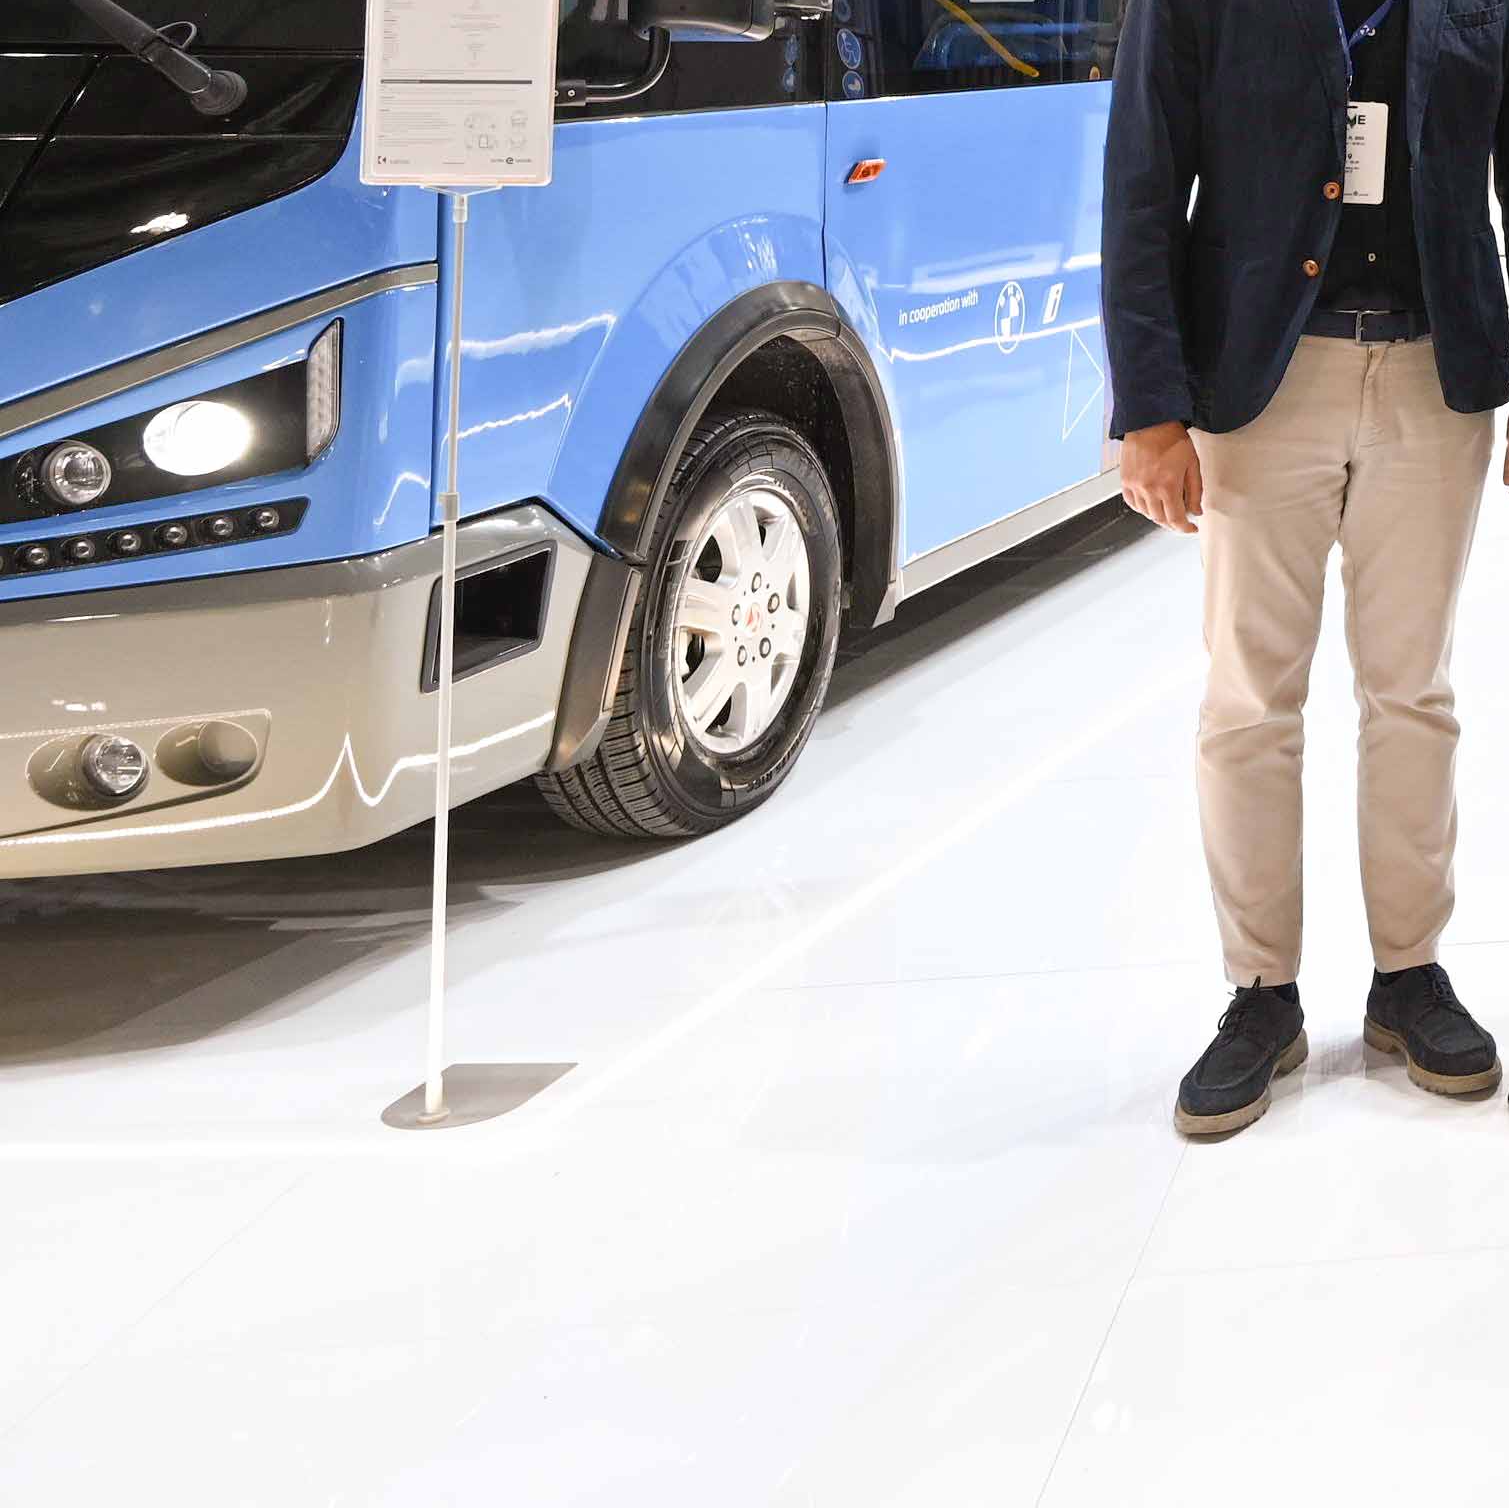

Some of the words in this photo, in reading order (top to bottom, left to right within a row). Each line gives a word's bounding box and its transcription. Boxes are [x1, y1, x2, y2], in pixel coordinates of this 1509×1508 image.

[898, 308, 908, 327] in
[909, 295, 961, 324] cooperation
[961, 288, 979, 309] with
